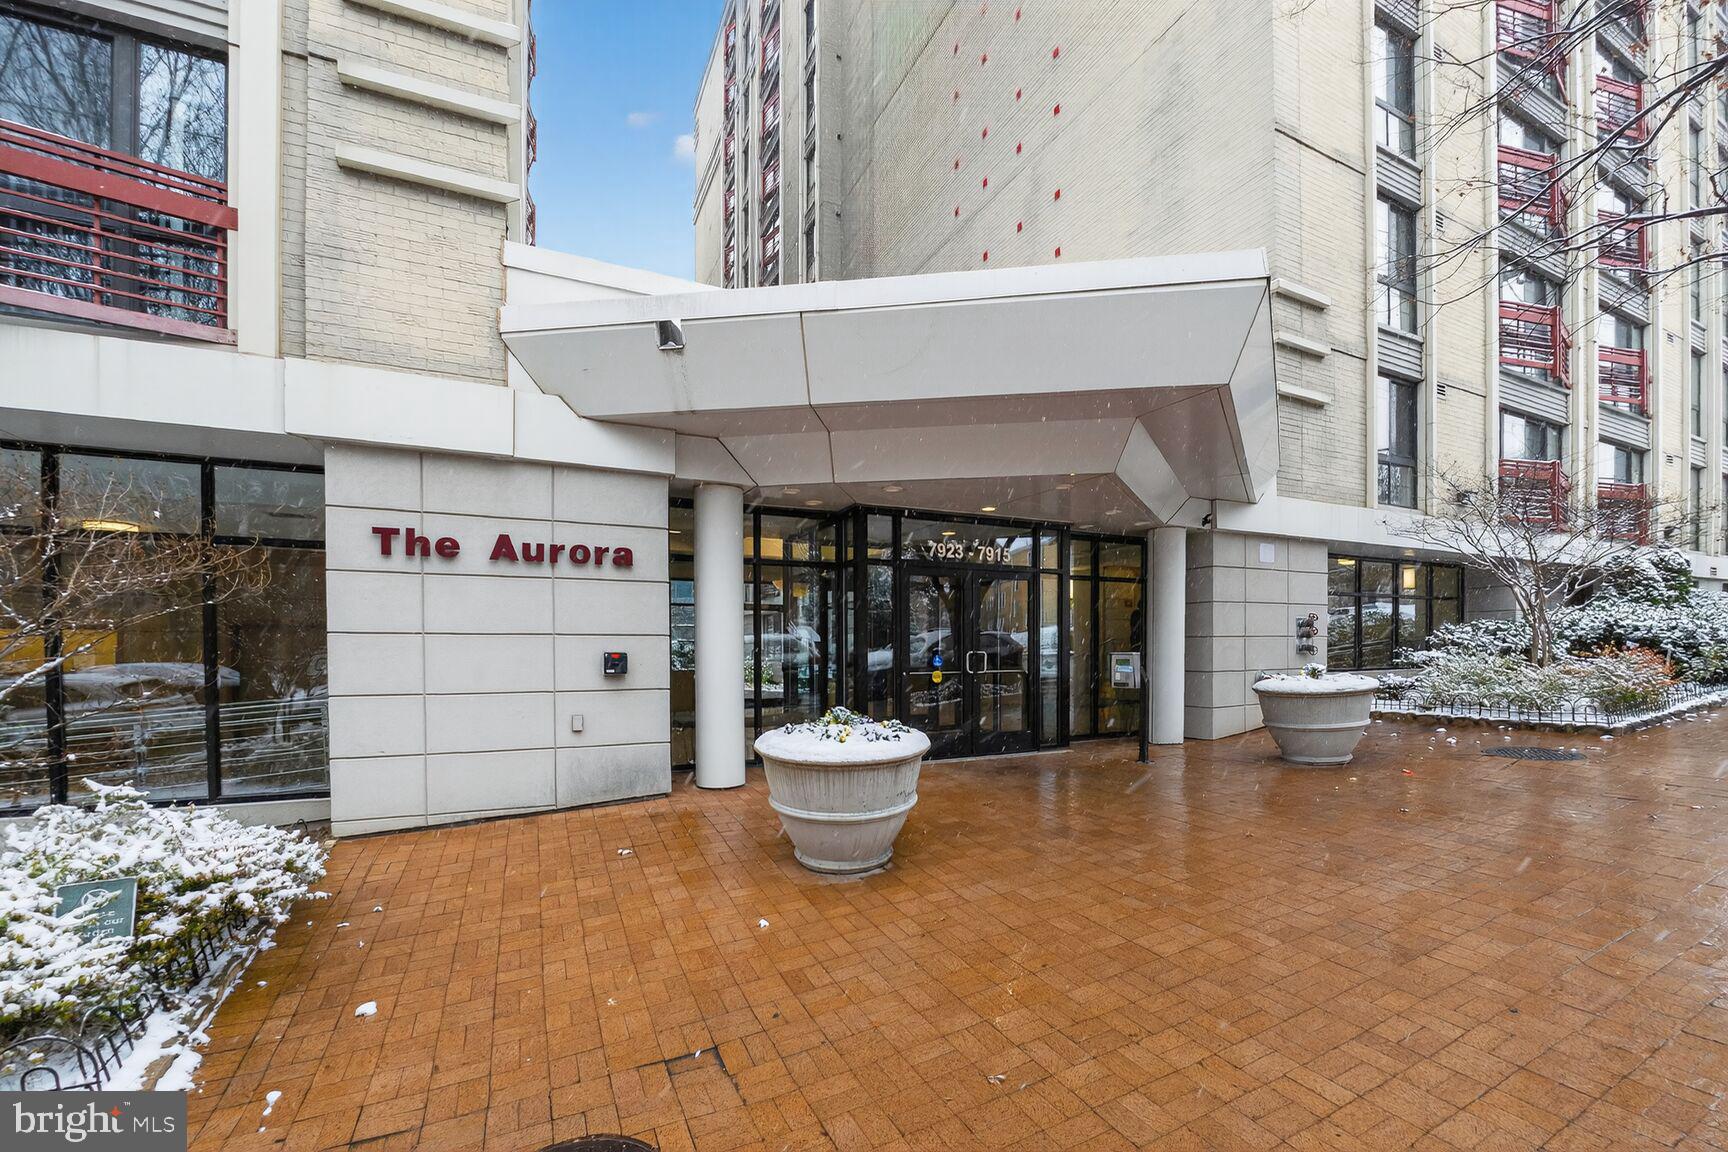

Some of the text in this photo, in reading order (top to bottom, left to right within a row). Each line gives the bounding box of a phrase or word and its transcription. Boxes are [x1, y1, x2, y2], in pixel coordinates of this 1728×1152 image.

[372, 526, 634, 567] The Aurora
[928, 540, 964, 559] 7923
[978, 546, 1010, 562] 7915
